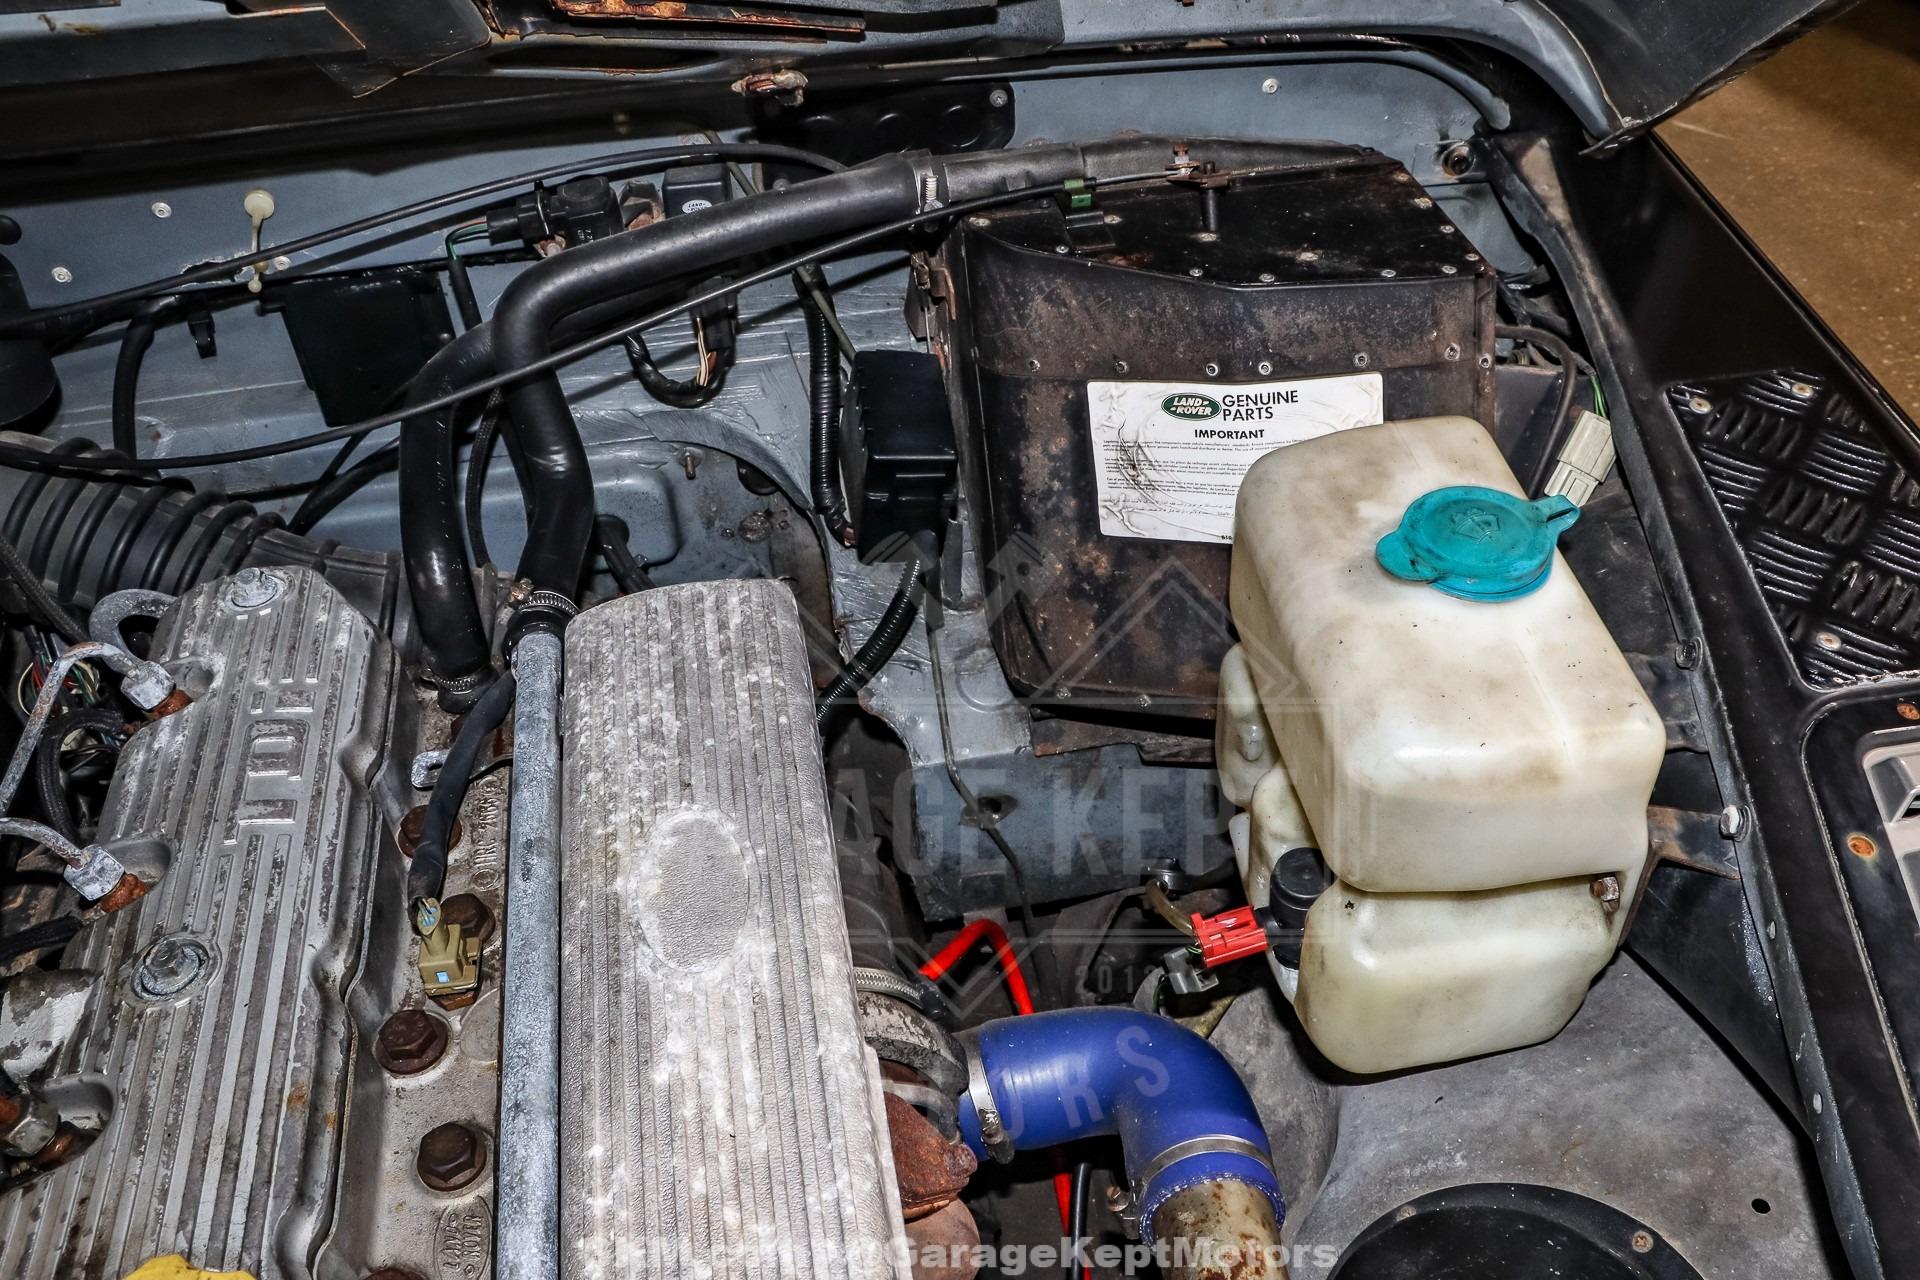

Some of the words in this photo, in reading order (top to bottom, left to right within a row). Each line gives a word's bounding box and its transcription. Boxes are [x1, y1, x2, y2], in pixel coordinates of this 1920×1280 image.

[1173, 396, 1204, 406] LAND
[1222, 390, 1298, 408] GENUINE
[1176, 405, 1212, 416] ROVER
[1223, 406, 1274, 421] PARTS
[1194, 429, 1265, 440] IMPORTANT
